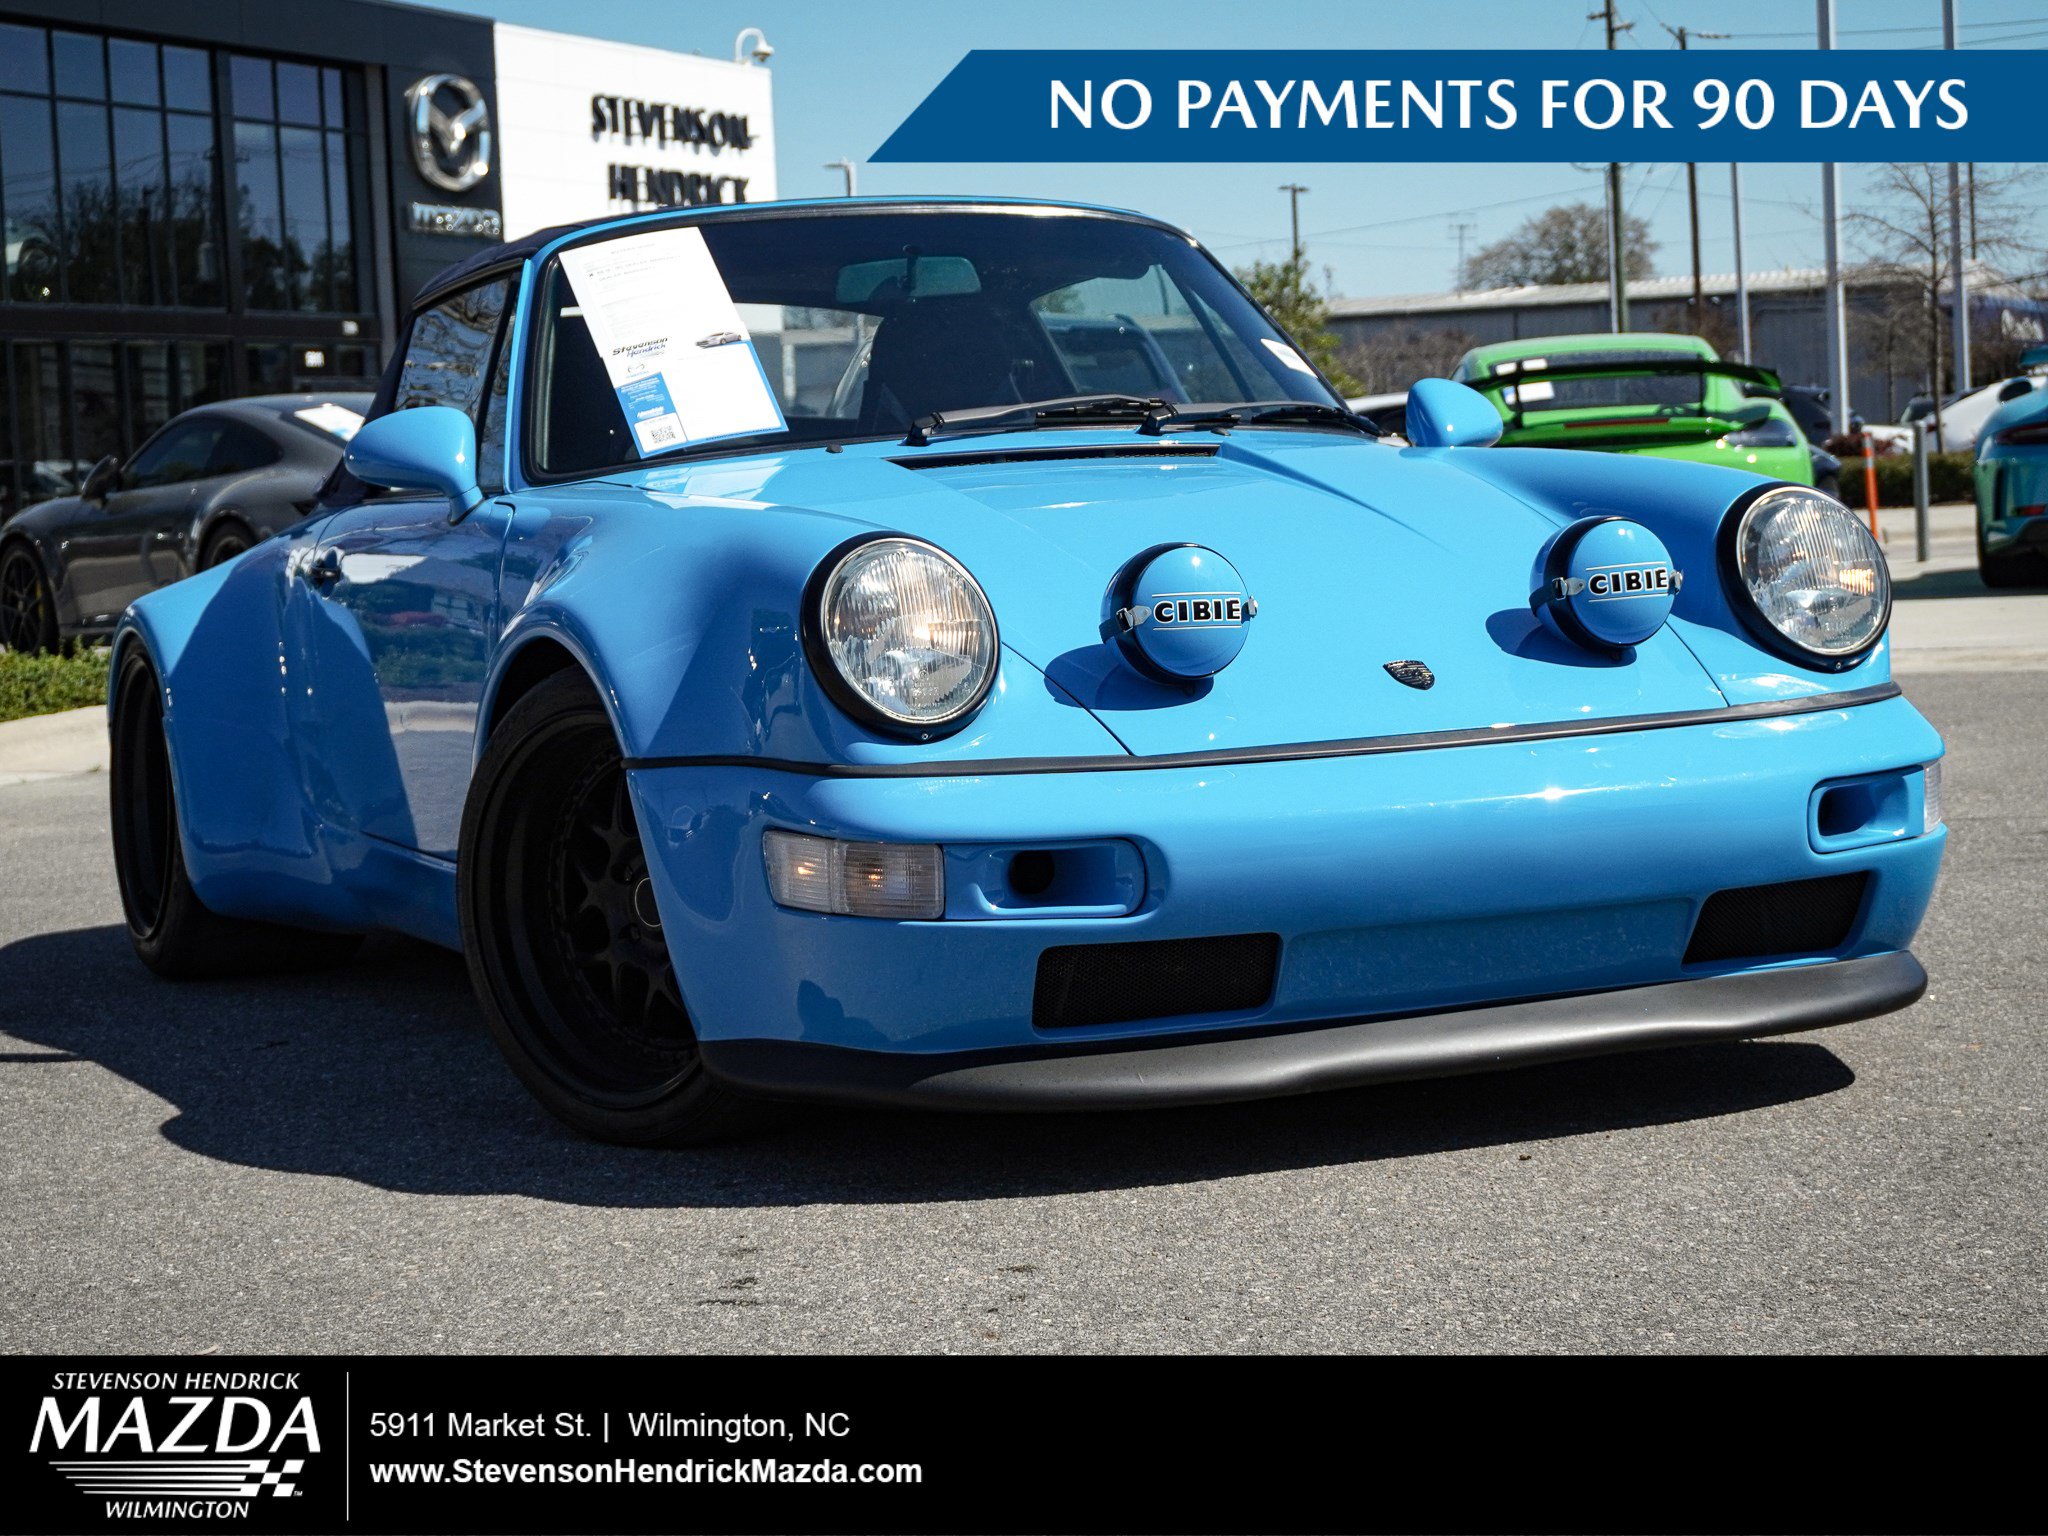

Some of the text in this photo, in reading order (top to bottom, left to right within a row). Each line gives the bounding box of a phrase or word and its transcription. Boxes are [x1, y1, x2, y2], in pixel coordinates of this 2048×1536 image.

[592, 94, 751, 150] STEVENSON
[608, 163, 750, 207] HENDRICK
[1585, 567, 1669, 595] CIBIE
[1154, 598, 1241, 623] CIBIE
